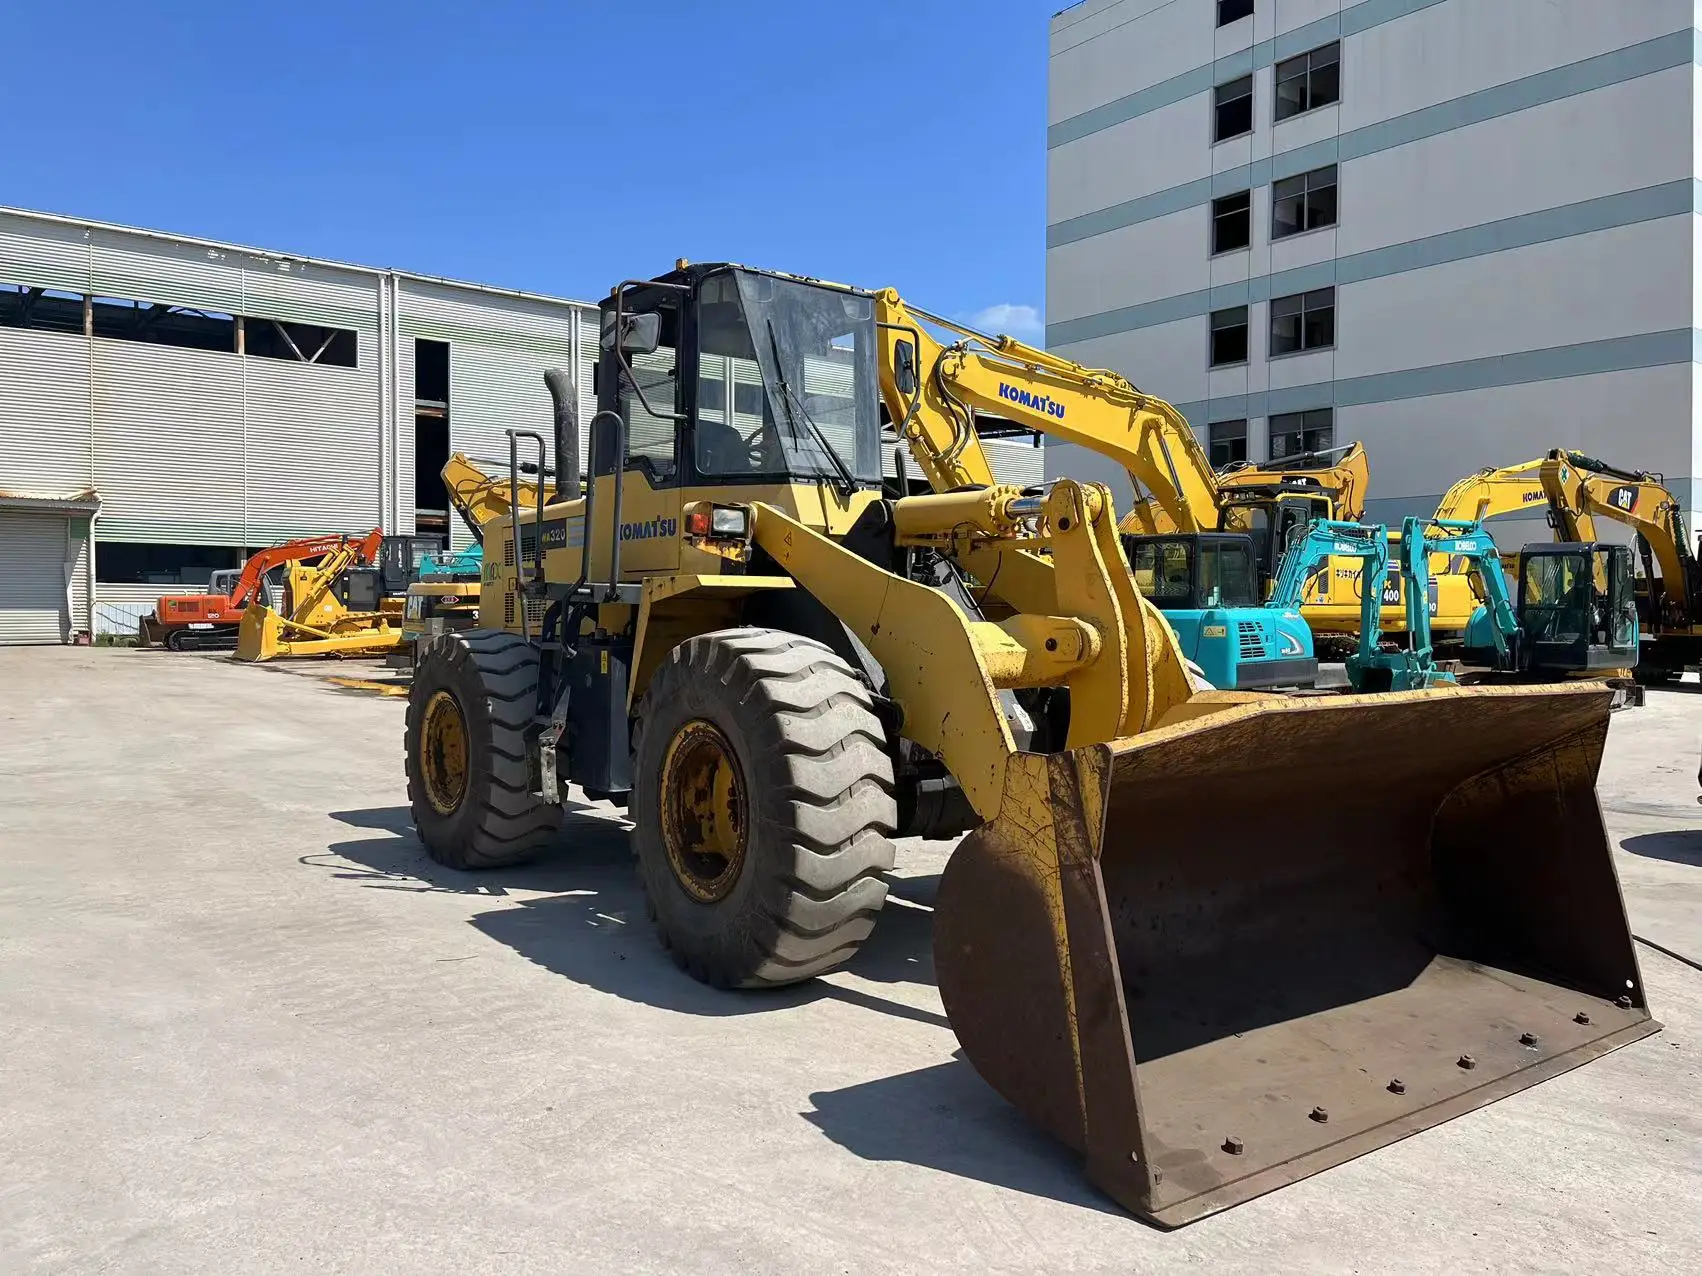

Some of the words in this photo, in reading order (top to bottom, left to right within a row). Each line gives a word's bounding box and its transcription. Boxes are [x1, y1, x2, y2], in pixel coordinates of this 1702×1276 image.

[999, 382, 1065, 418] KOMATSU
[1618, 488, 1632, 510] CAT
[1454, 540, 1476, 551] KOBELCO
[1383, 589, 1399, 601] 400
